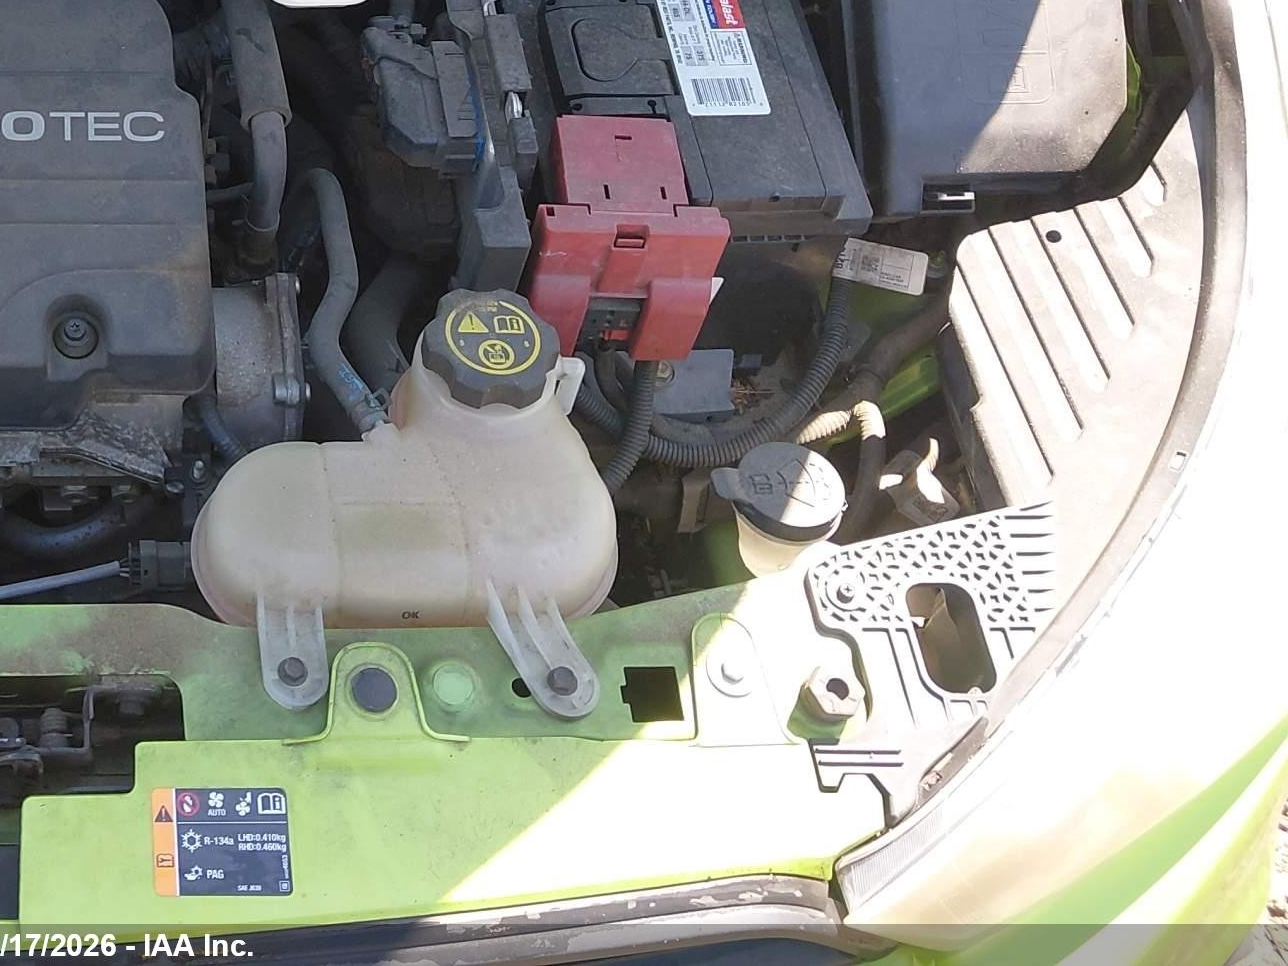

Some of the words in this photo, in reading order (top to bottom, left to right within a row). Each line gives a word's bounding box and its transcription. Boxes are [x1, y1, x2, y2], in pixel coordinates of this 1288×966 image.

[401, 610, 421, 620] OK
[204, 837, 234, 845] R-134a
[237, 833, 286, 843] LHD:0.410kg
[206, 869, 225, 879] PAG
